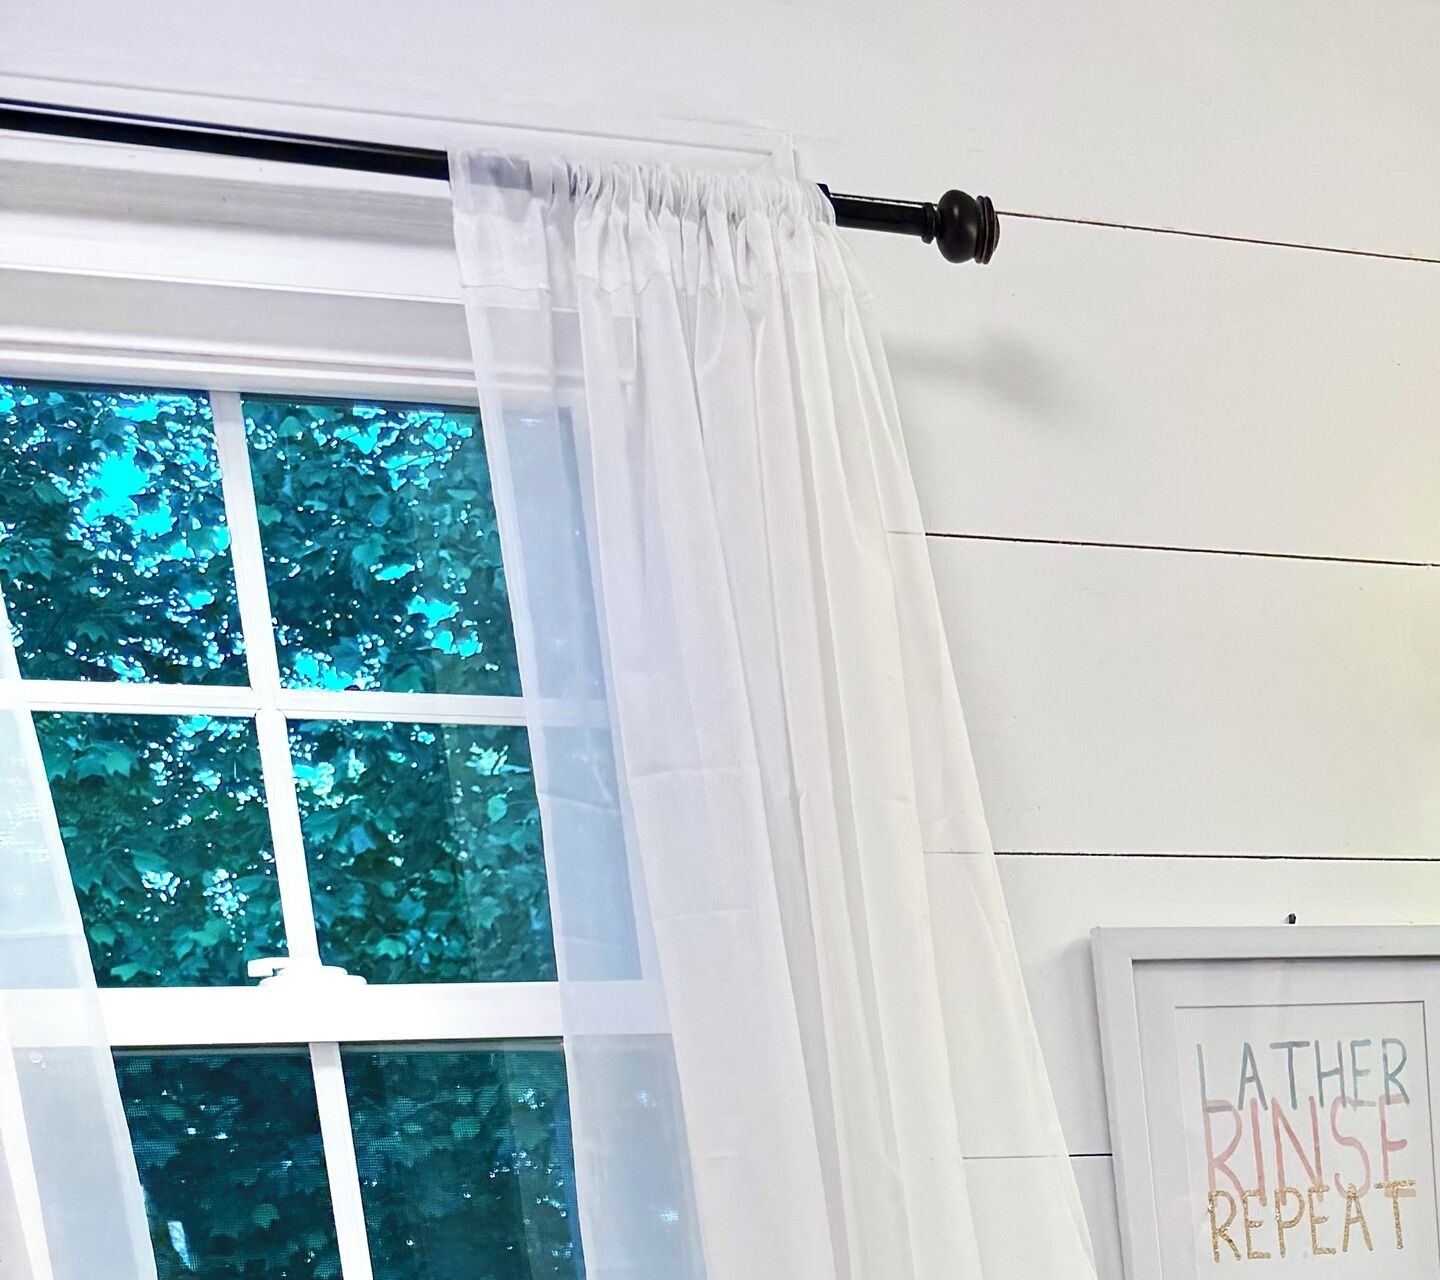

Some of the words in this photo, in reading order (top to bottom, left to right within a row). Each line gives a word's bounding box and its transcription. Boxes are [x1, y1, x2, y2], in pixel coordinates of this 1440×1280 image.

[1196, 1038, 1410, 1111] LATHER
[1203, 1094, 1417, 1207] RINSE
[1206, 1179, 1416, 1263] REPEAT
